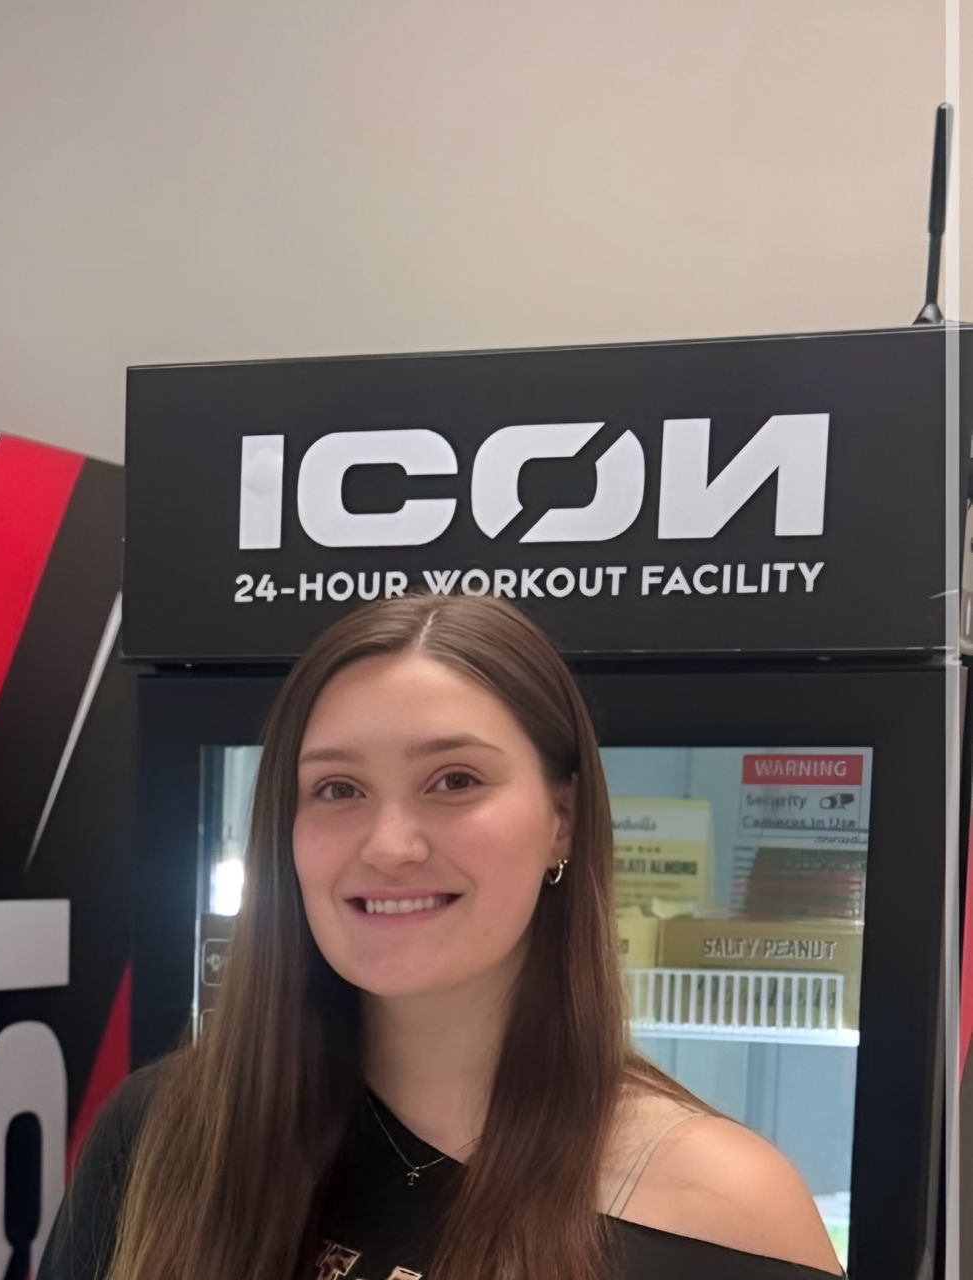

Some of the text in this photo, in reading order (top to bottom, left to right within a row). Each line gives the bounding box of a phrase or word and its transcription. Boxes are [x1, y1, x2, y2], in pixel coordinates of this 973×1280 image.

[238, 413, 830, 549] ICON
[234, 562, 824, 602] 24-HOUR WORKOUT FACILITY
[754, 760, 847, 776] WARNING
[746, 792, 808, 810] Security
[703, 937, 838, 961] SALTY PEANUT
